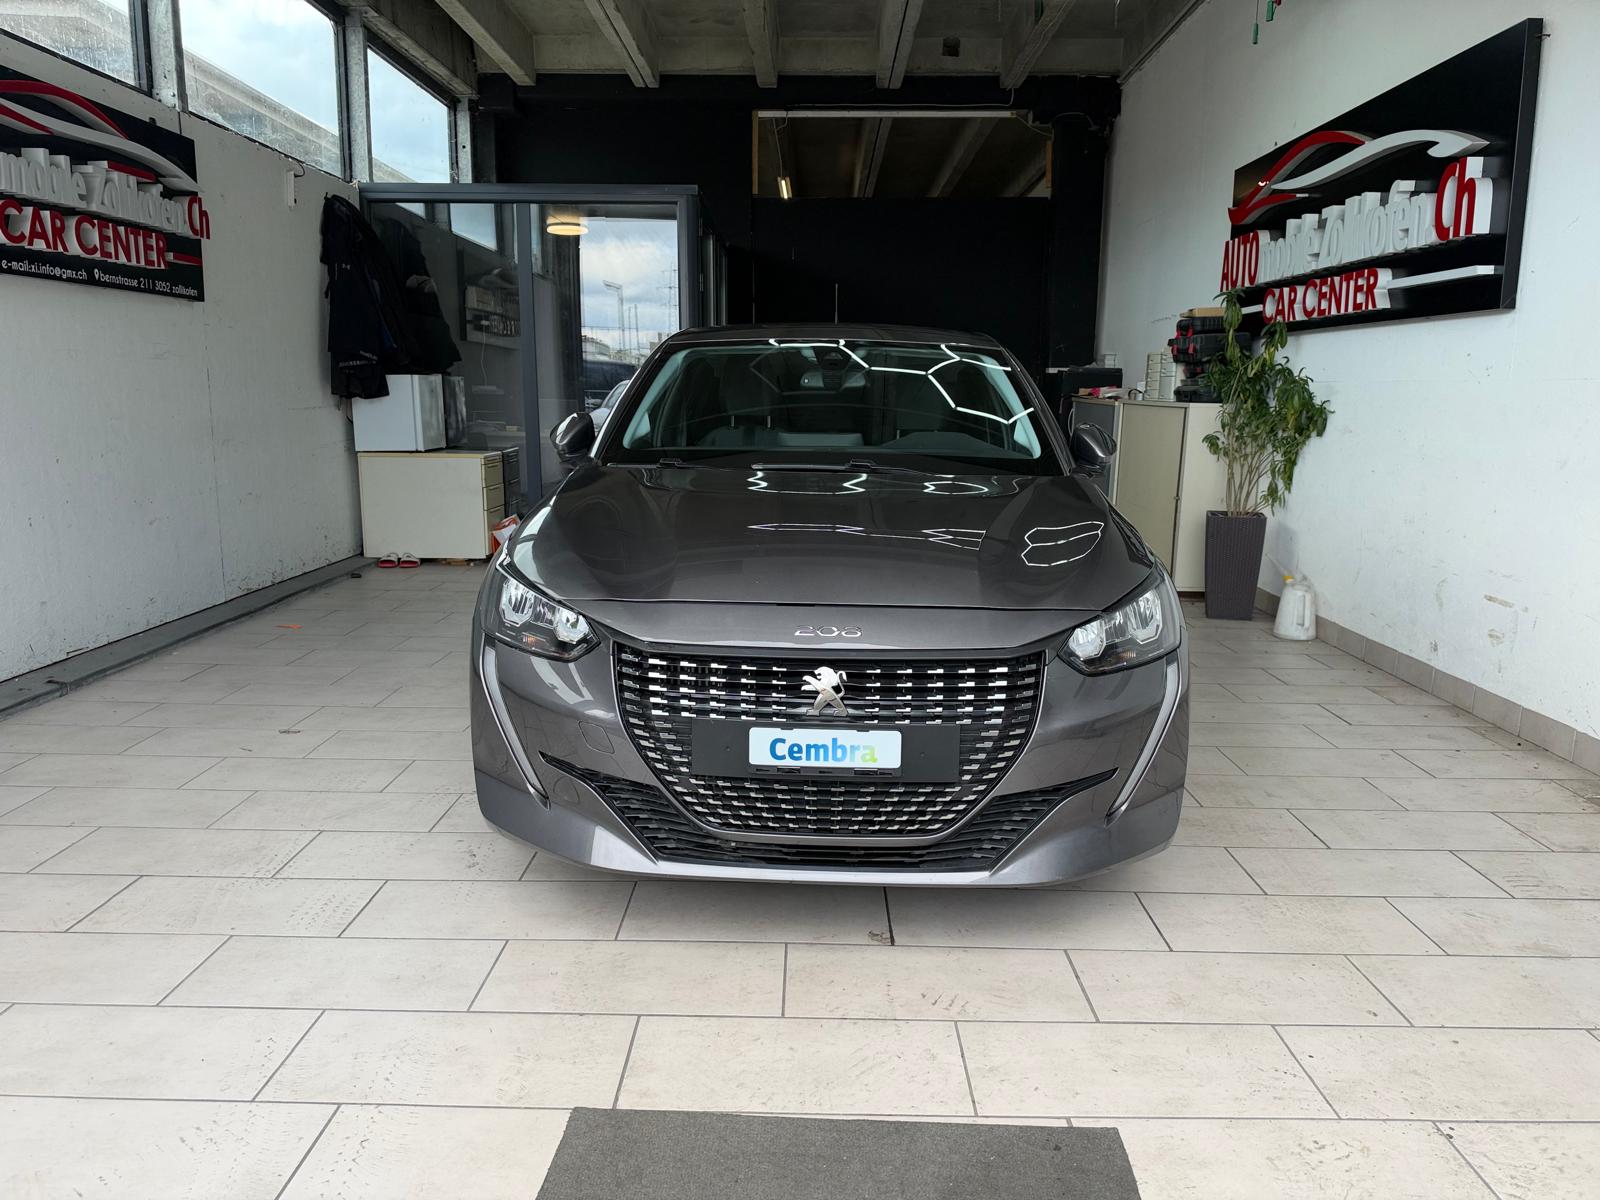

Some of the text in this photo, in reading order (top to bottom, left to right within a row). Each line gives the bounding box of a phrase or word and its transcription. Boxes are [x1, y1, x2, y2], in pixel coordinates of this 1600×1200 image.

[0, 198, 168, 269] CAR CENTER
[155, 280, 171, 293] 3052
[1263, 267, 1379, 324] CAR CENTER
[794, 625, 863, 638] 208
[769, 737, 878, 763] Cembra
